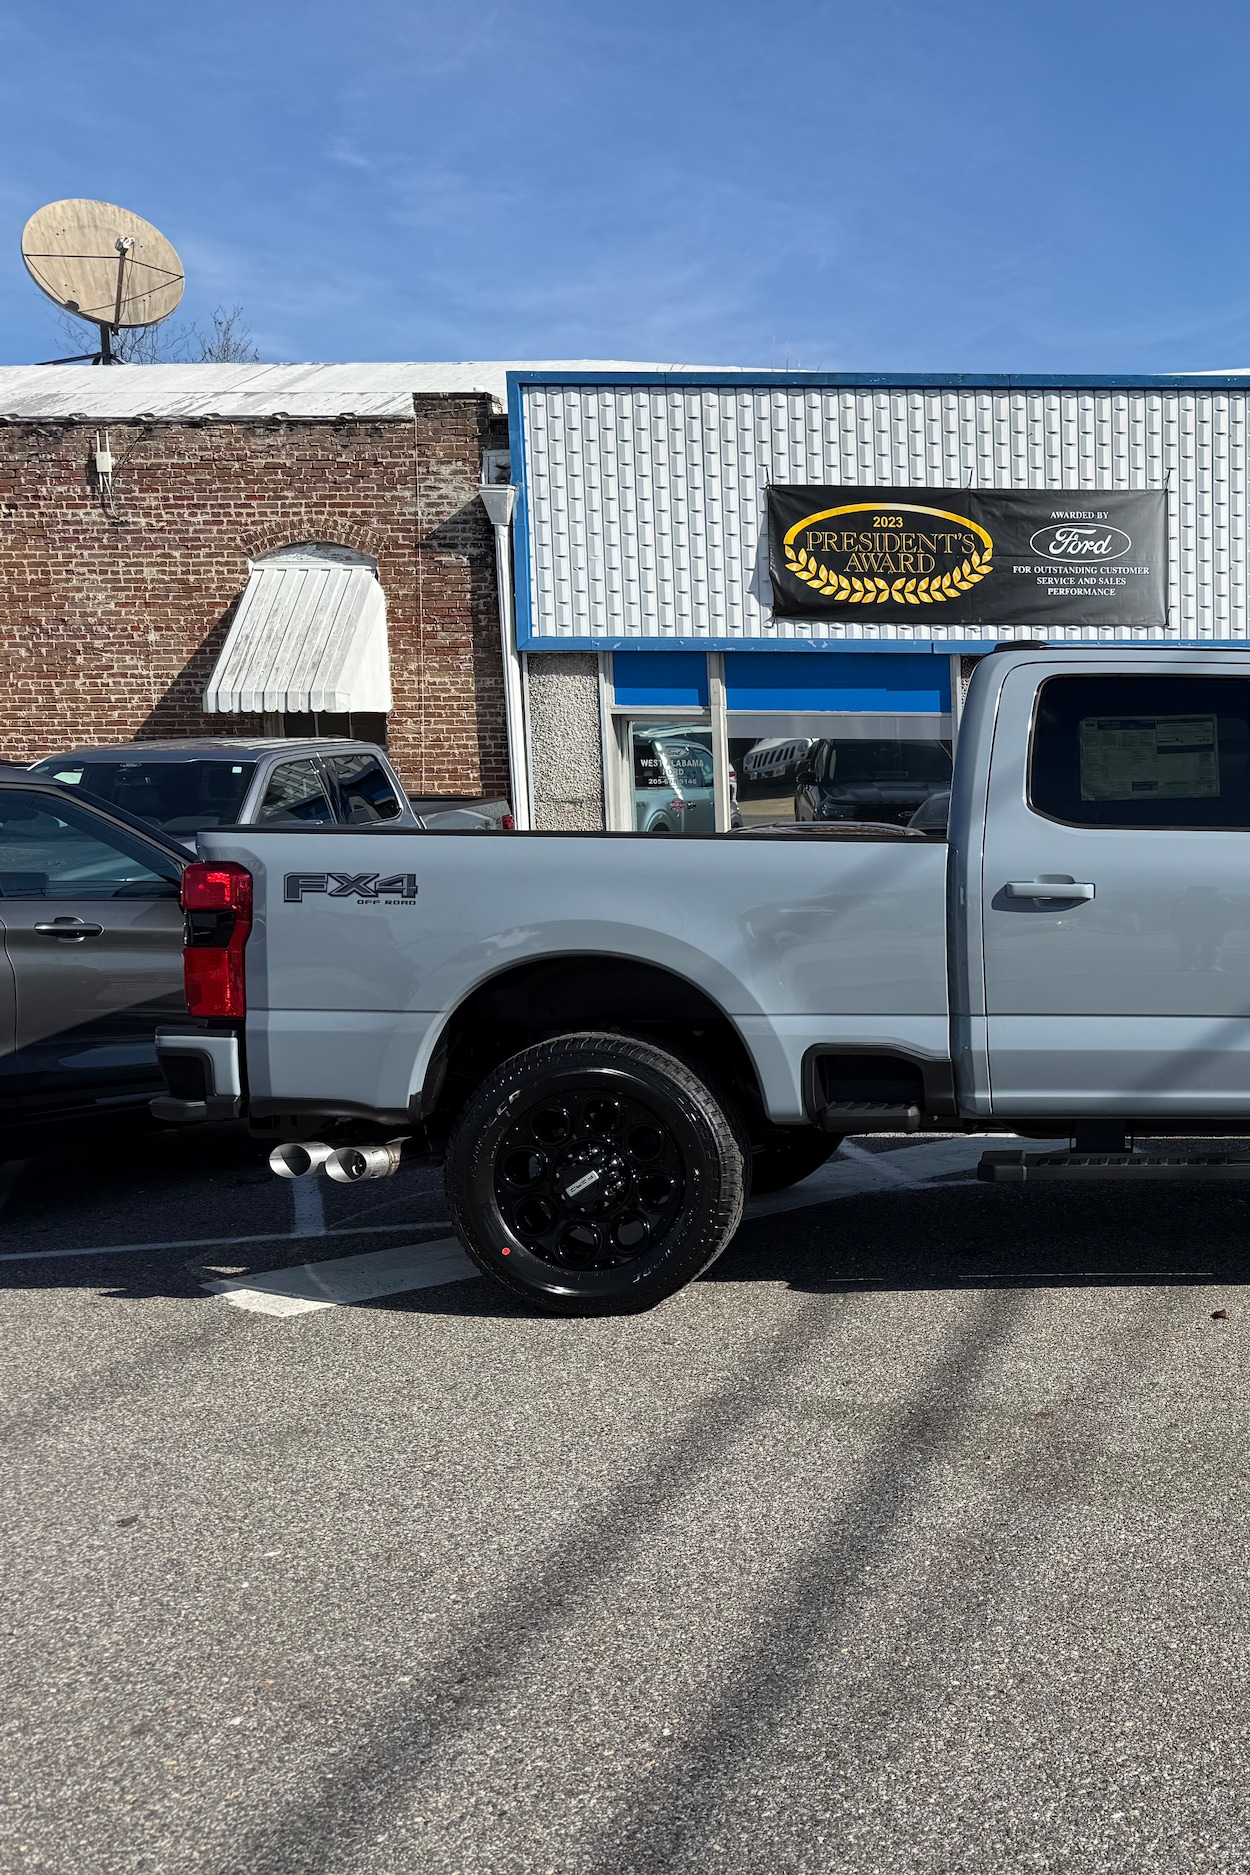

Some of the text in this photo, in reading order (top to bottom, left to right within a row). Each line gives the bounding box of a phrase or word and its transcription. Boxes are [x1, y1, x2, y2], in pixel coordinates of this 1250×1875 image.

[1050, 511, 1109, 519] AWARDED BY
[873, 516, 904, 528] 2023
[806, 531, 976, 554] PRESIDENT'S
[1048, 527, 1112, 555] Ford
[843, 552, 936, 574] AWARD
[1012, 565, 1150, 575] FOR OUTSTANDING CUSTOMER
[1036, 577, 1127, 585] SERVICE AND SALES
[1047, 587, 1116, 596] PERFORMANCE
[666, 759, 705, 768] LABAMA
[283, 872, 418, 903] FX4
